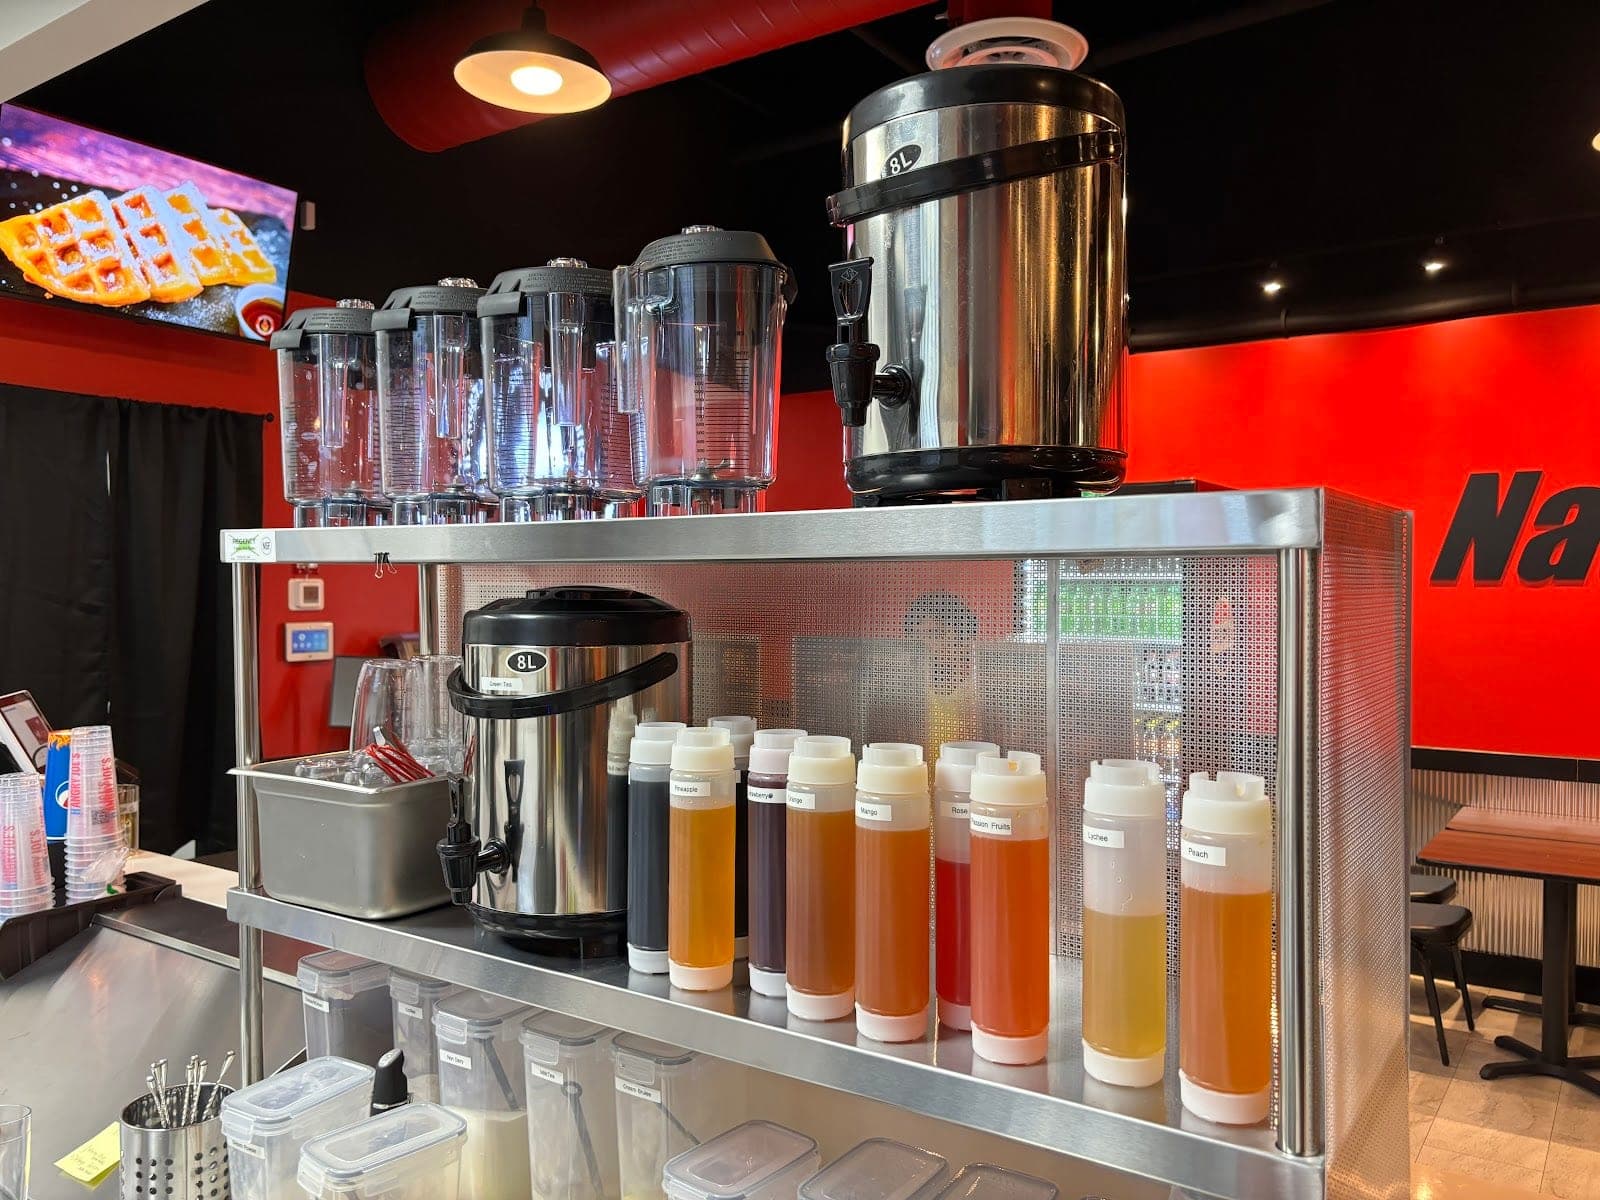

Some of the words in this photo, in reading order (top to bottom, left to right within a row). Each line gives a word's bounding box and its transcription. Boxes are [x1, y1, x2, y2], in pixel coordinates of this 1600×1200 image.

[890, 152, 912, 175] 8L
[517, 655, 536, 669] 8L
[991, 821, 1011, 831] Fruits
[1088, 832, 1108, 842] Lychee
[1188, 847, 1209, 859] Peach
